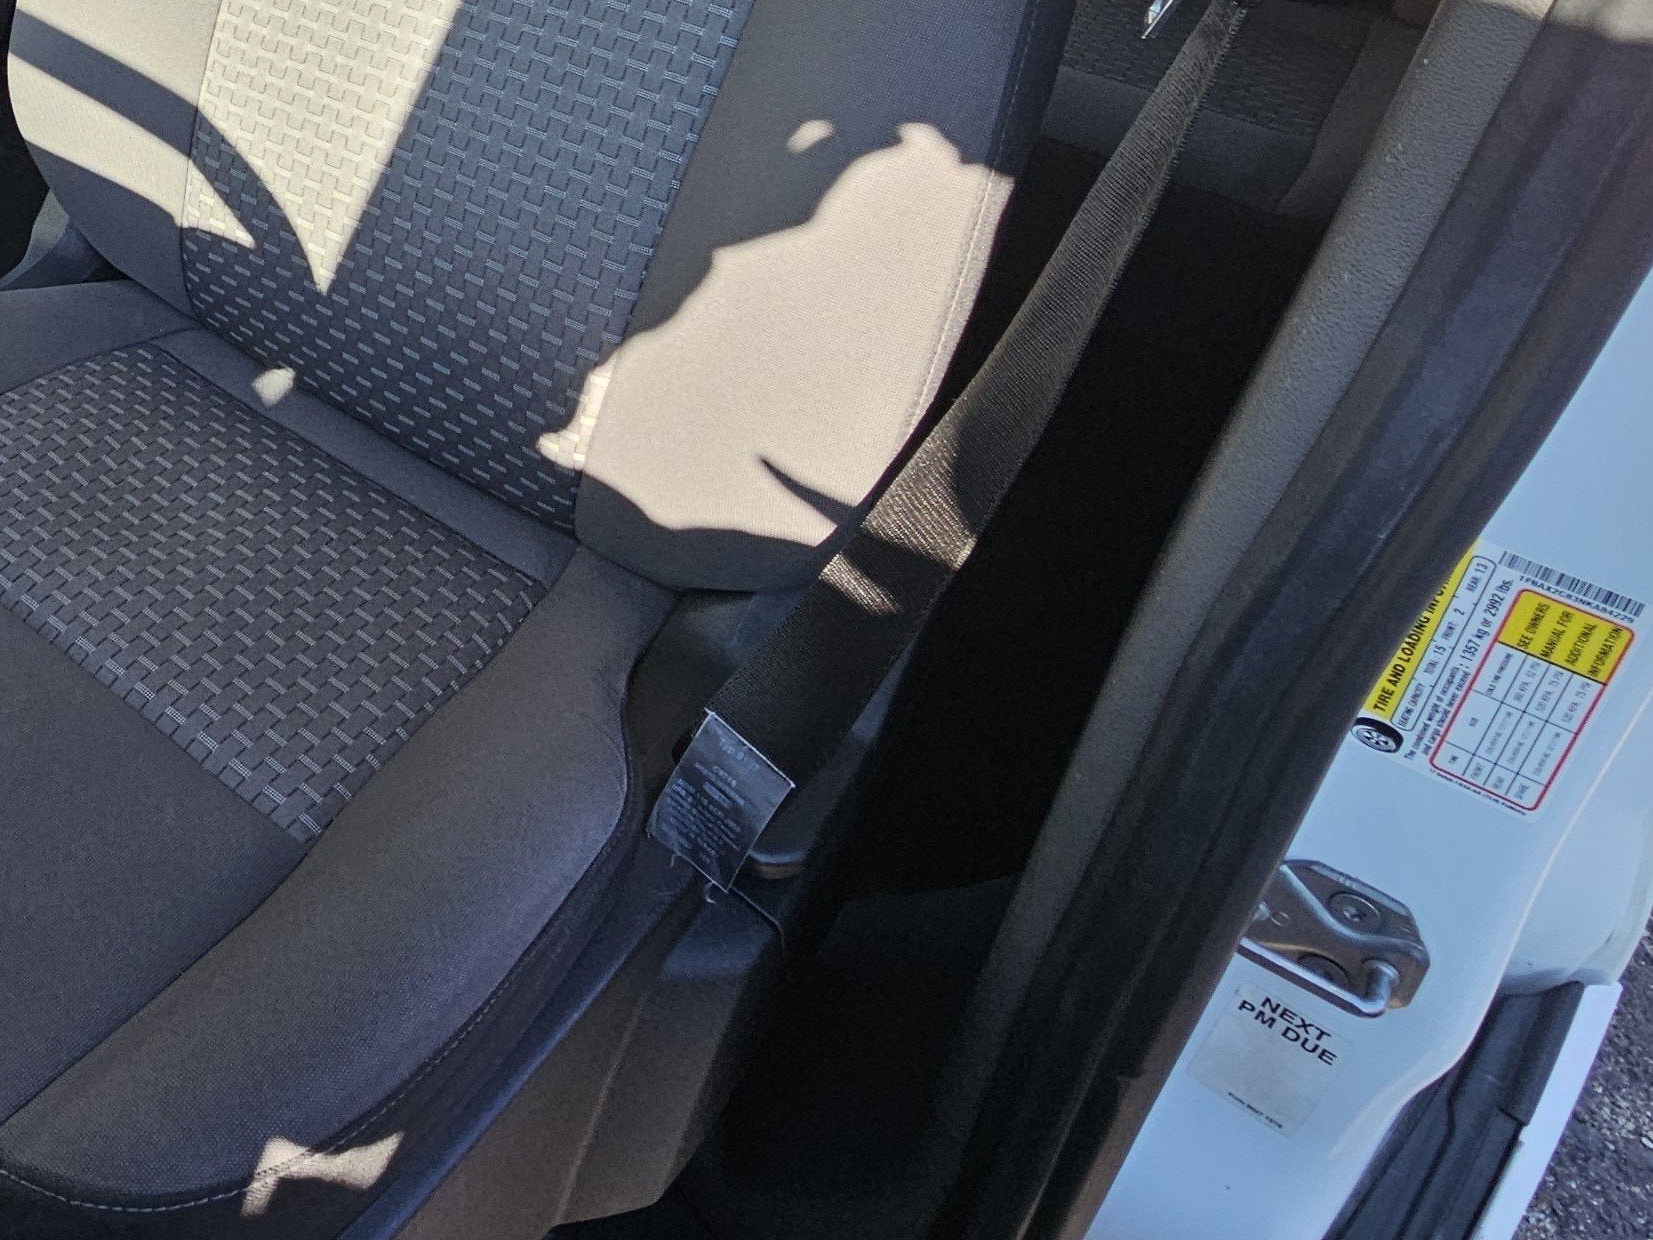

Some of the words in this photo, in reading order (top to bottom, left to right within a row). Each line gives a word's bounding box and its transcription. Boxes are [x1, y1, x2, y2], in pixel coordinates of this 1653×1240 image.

[1474, 562, 1488, 574] 13
[1495, 580, 1514, 593] lbs.
[1453, 608, 1465, 616] 2
[1483, 593, 1505, 617] 2992
[1472, 628, 1490, 640] kg
[1480, 617, 1492, 628] or
[1517, 634, 1533, 649] SEE
[1525, 603, 1550, 634] OWNERS
[1540, 628, 1565, 658] MANUAL
[1556, 611, 1574, 628] FOR
[1433, 645, 1446, 656] 15
[1460, 639, 1480, 661] 1357
[1565, 623, 1597, 666] ADDITIONAL
[1588, 626, 1623, 677] INFORMATION
[1373, 687, 1395, 711] TIRE
[1387, 664, 1406, 687] AND
[1398, 613, 1430, 663] LOADING
[1261, 996, 1331, 1041] NEXT
[1238, 999, 1276, 1029] PM
[1281, 1025, 1337, 1066] DUE
